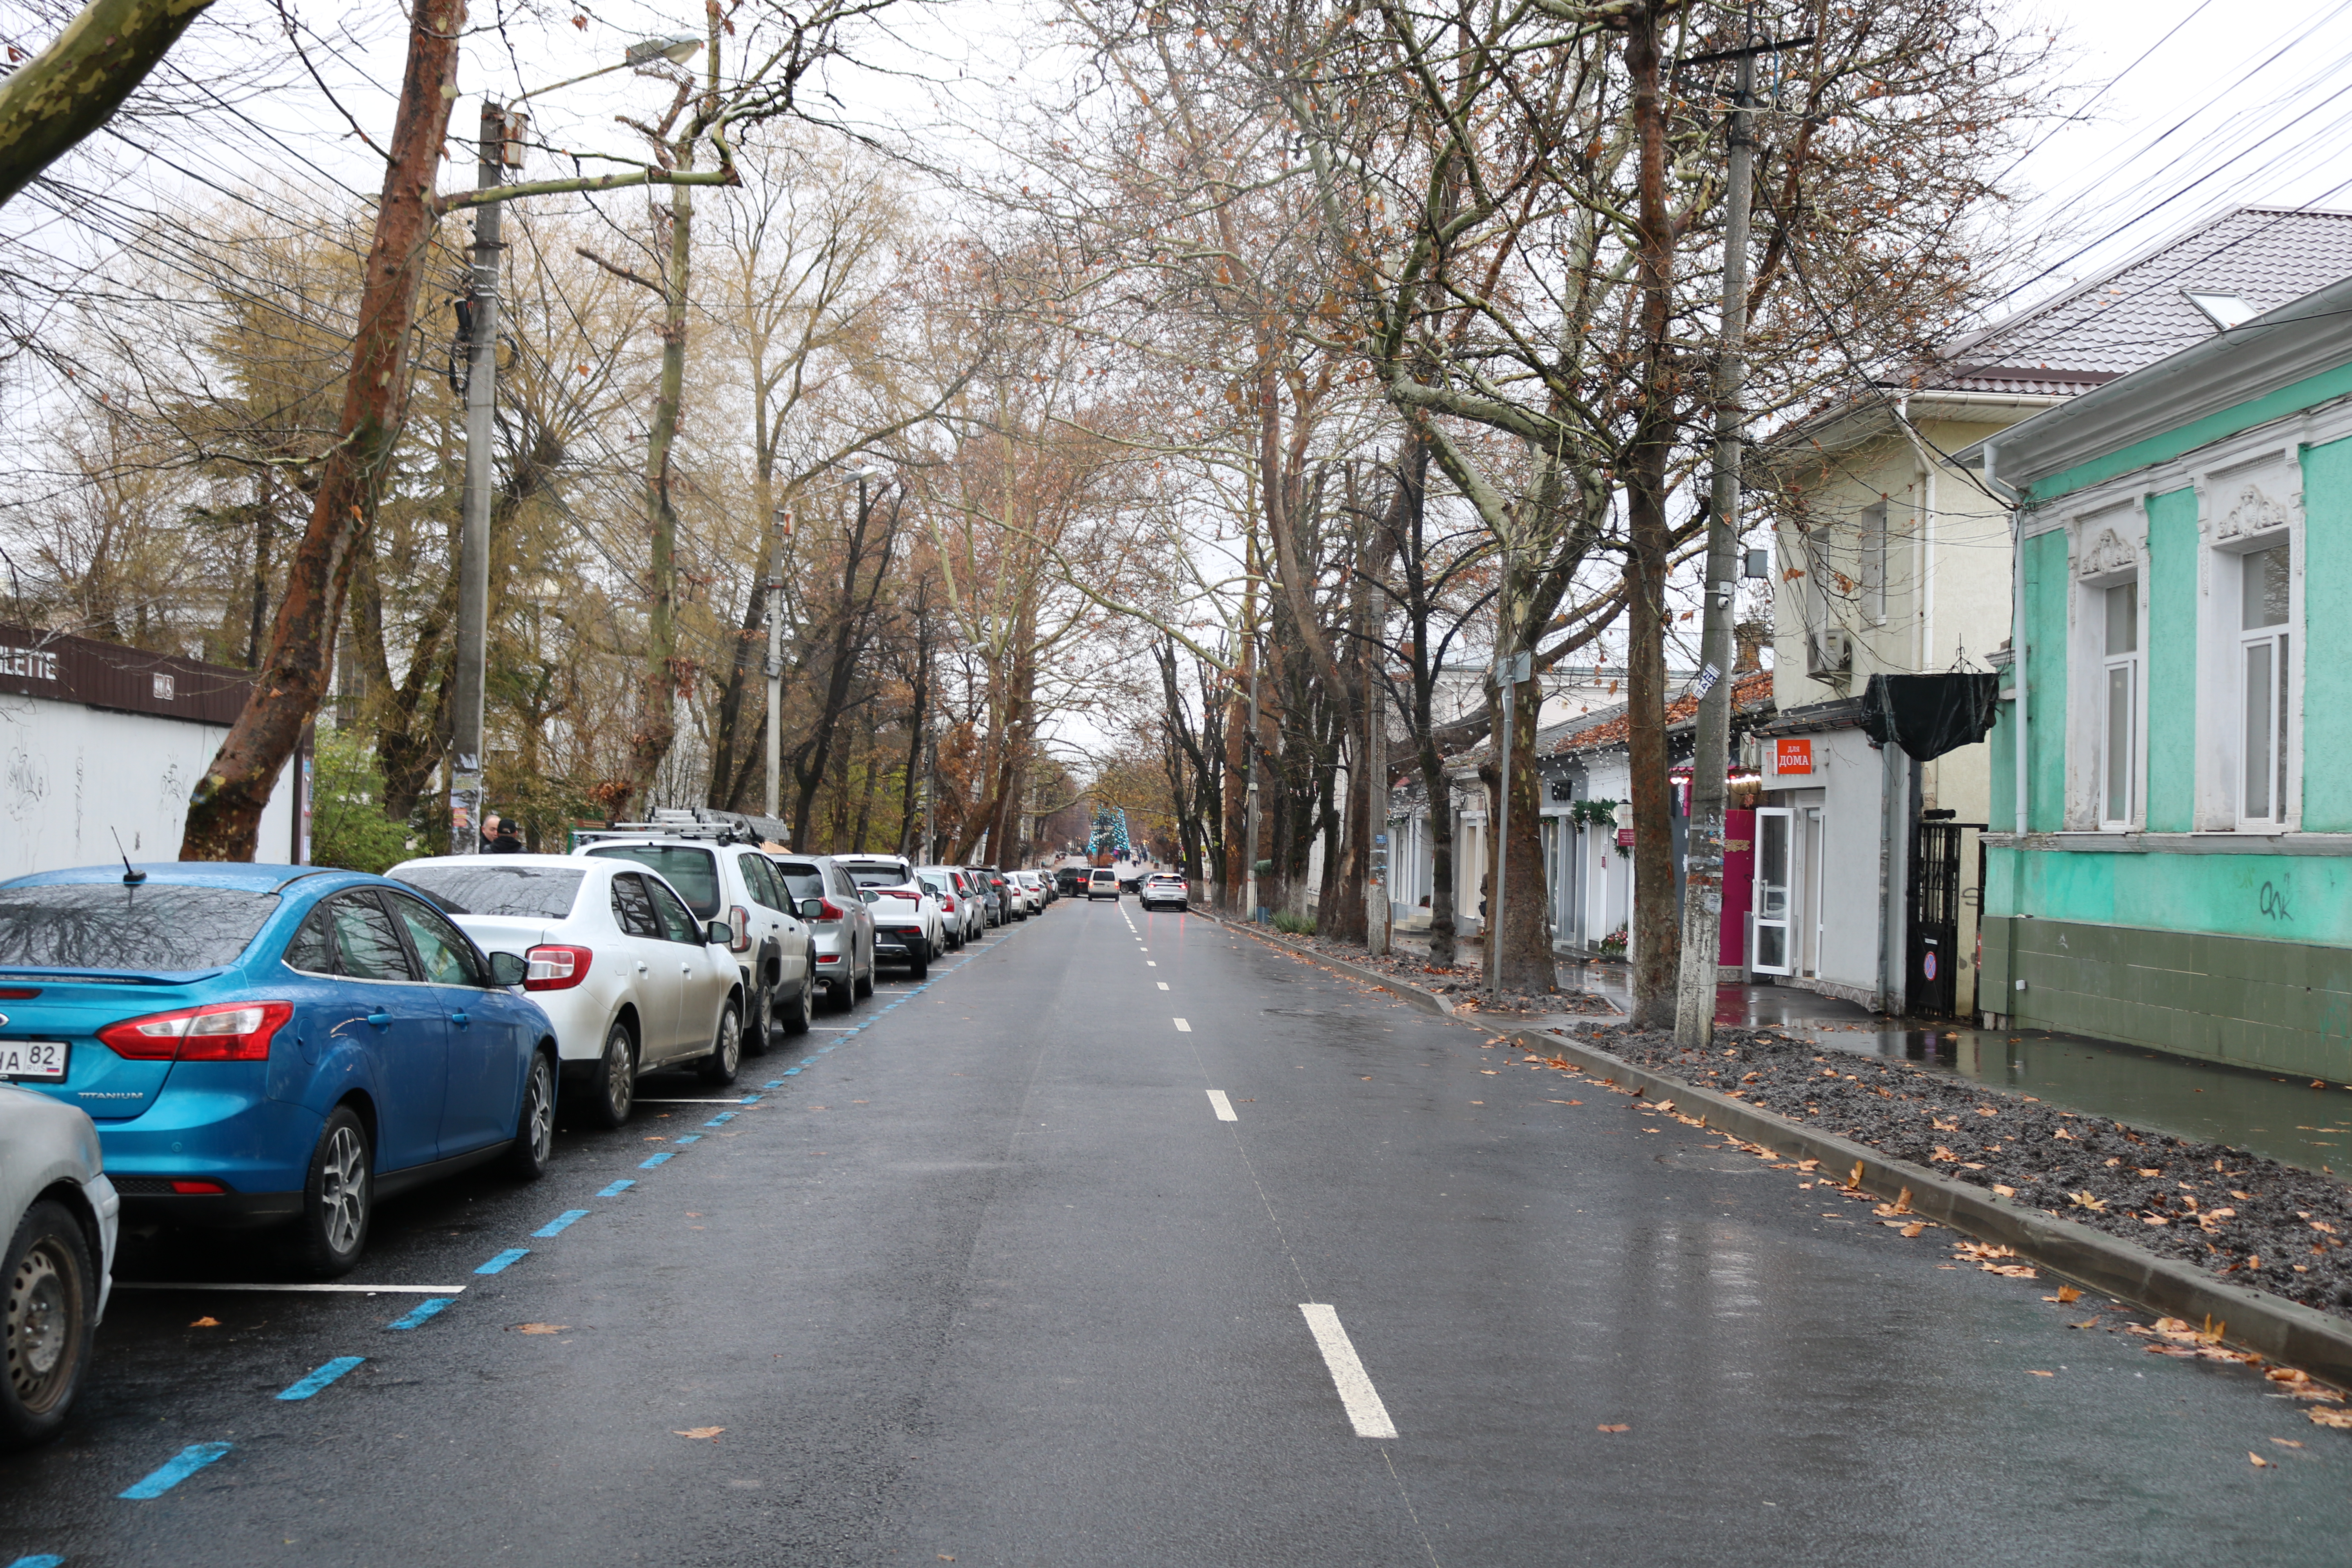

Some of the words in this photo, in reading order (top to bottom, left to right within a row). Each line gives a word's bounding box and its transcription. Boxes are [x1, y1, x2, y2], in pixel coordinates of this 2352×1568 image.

[1779, 755, 1809, 768] ДОМА
[30, 1046, 54, 1064] 82
[27, 1063, 46, 1073] RUS
